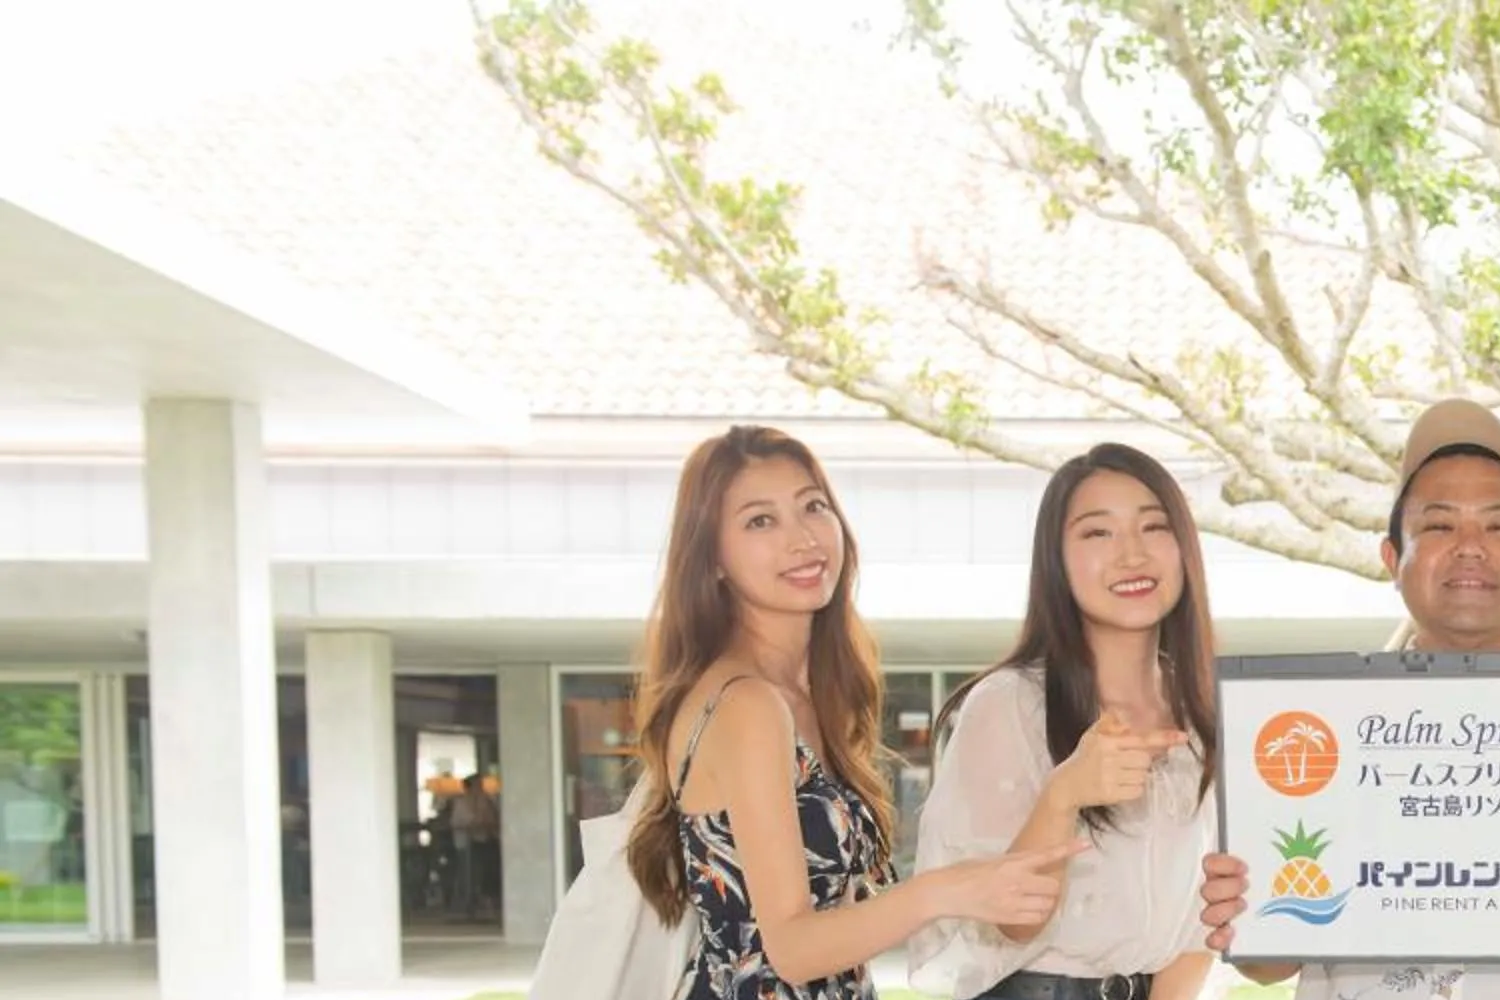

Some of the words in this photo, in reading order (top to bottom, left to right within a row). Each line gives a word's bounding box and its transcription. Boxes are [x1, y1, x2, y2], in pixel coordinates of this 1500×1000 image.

[1357, 709, 1442, 745] Palm
[1381, 897, 1427, 911] PINE
[1431, 897, 1480, 911] RENT
[1485, 897, 1498, 911] A
